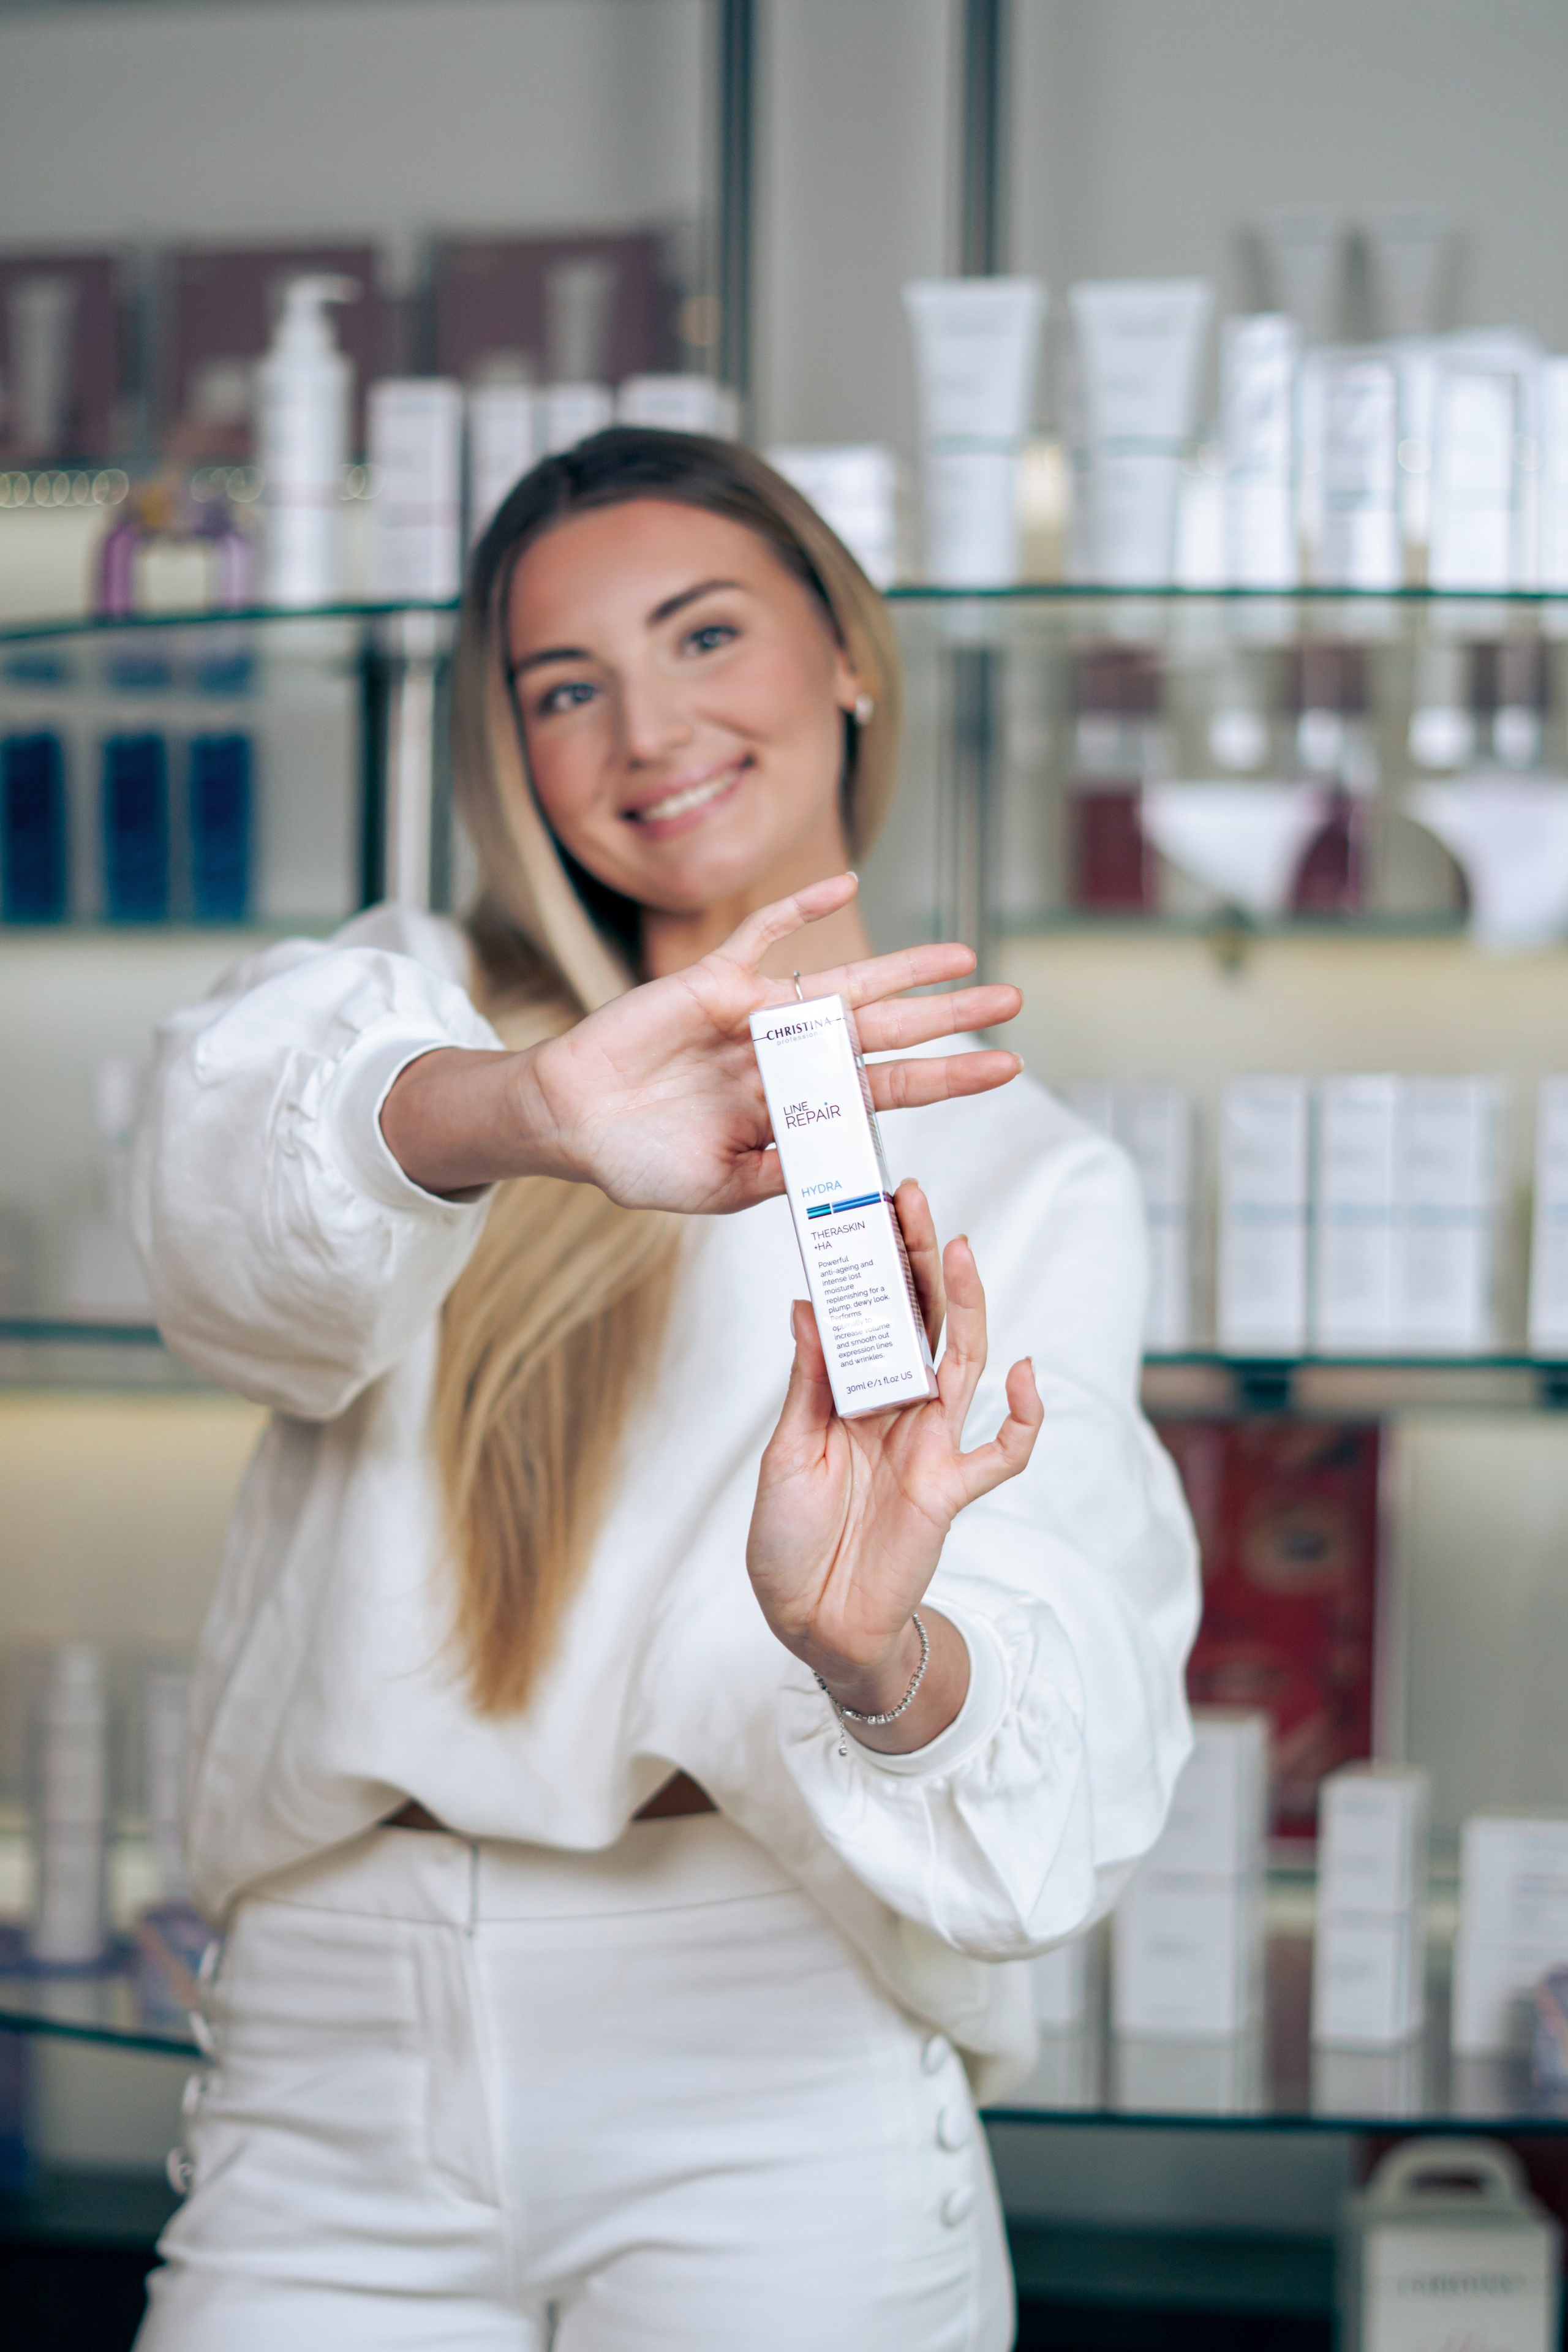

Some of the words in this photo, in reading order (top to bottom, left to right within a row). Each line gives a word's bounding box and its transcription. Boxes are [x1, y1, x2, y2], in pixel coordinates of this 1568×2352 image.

[766, 1017, 832, 1041] CHRISTINA
[783, 1101, 809, 1116] LINE
[786, 1102, 841, 1129] REPAIR
[801, 1180, 842, 1197] HYDRA
[811, 1221, 865, 1240] THERASKIN
[814, 1241, 832, 1251] +HA
[818, 1256, 849, 1268] Powerful
[820, 1264, 859, 1277] anti-ageing
[860, 1259, 873, 1268] and
[822, 1276, 847, 1286] intense
[824, 1284, 854, 1295] moisture
[826, 1290, 869, 1304] replenishing
[873, 1294, 890, 1303] look.
[830, 1311, 862, 1322] Performs
[832, 1319, 864, 1332] optimally
[834, 1329, 863, 1340] increase
[864, 1323, 890, 1333] volume
[837, 1341, 850, 1349] and
[851, 1335, 876, 1346] smooth
[839, 1346, 875, 1359] expression
[840, 1359, 854, 1367] and
[854, 1353, 885, 1363] wrinkles.
[846, 1382, 866, 1394] 30ml
[900, 1371, 913, 1380] US
